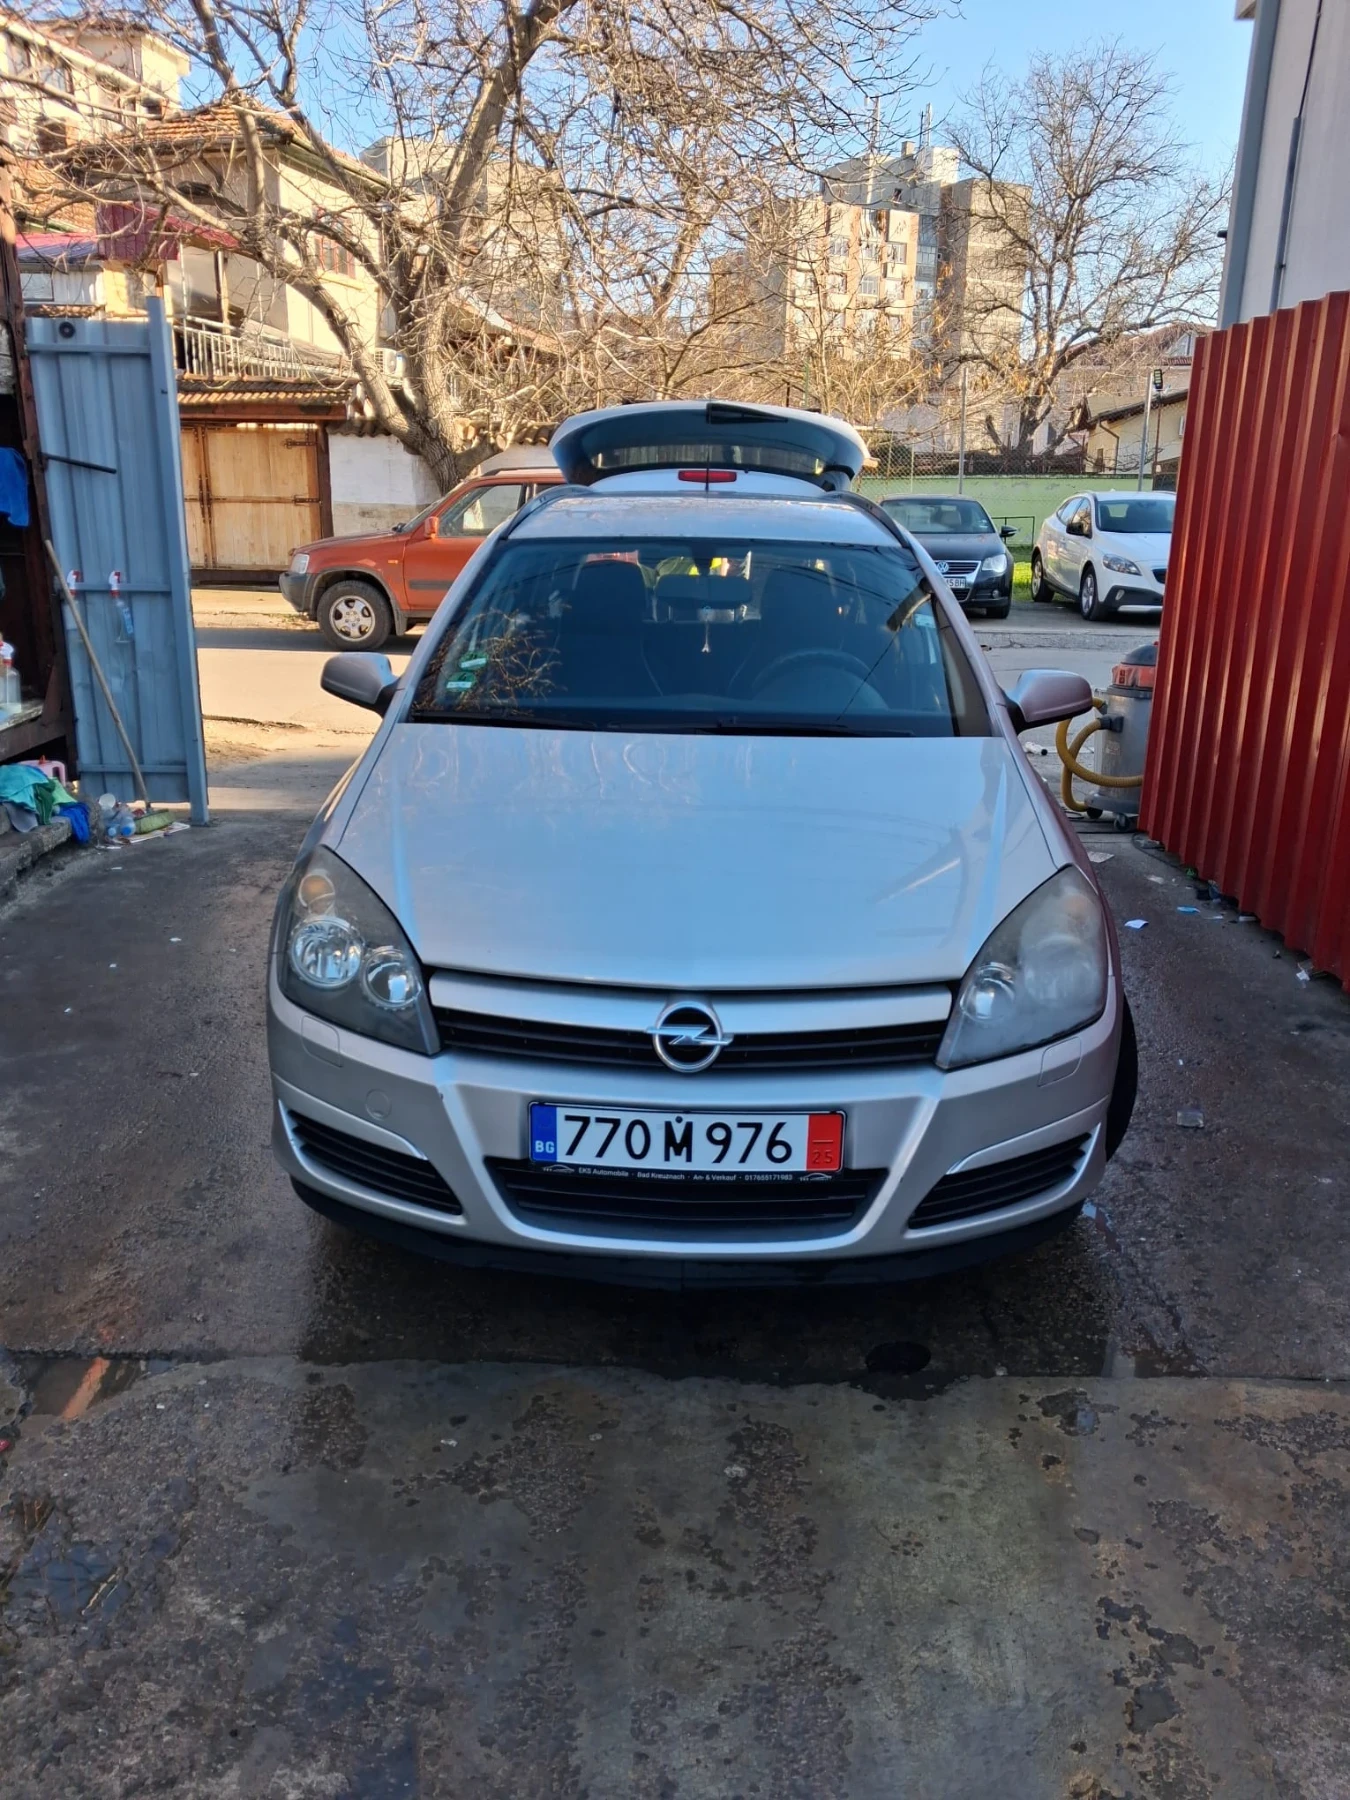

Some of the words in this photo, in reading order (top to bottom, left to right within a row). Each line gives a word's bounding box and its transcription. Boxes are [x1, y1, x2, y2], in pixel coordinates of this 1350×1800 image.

[564, 1115, 651, 1160] 770
[663, 1120, 693, 1162] M
[706, 1122, 793, 1163] 976
[535, 1140, 555, 1154] BG
[812, 1149, 833, 1164] 25
[592, 1168, 629, 1177] Automobile
[637, 1171, 650, 1179] Bad
[651, 1172, 685, 1180] Kreuznach
